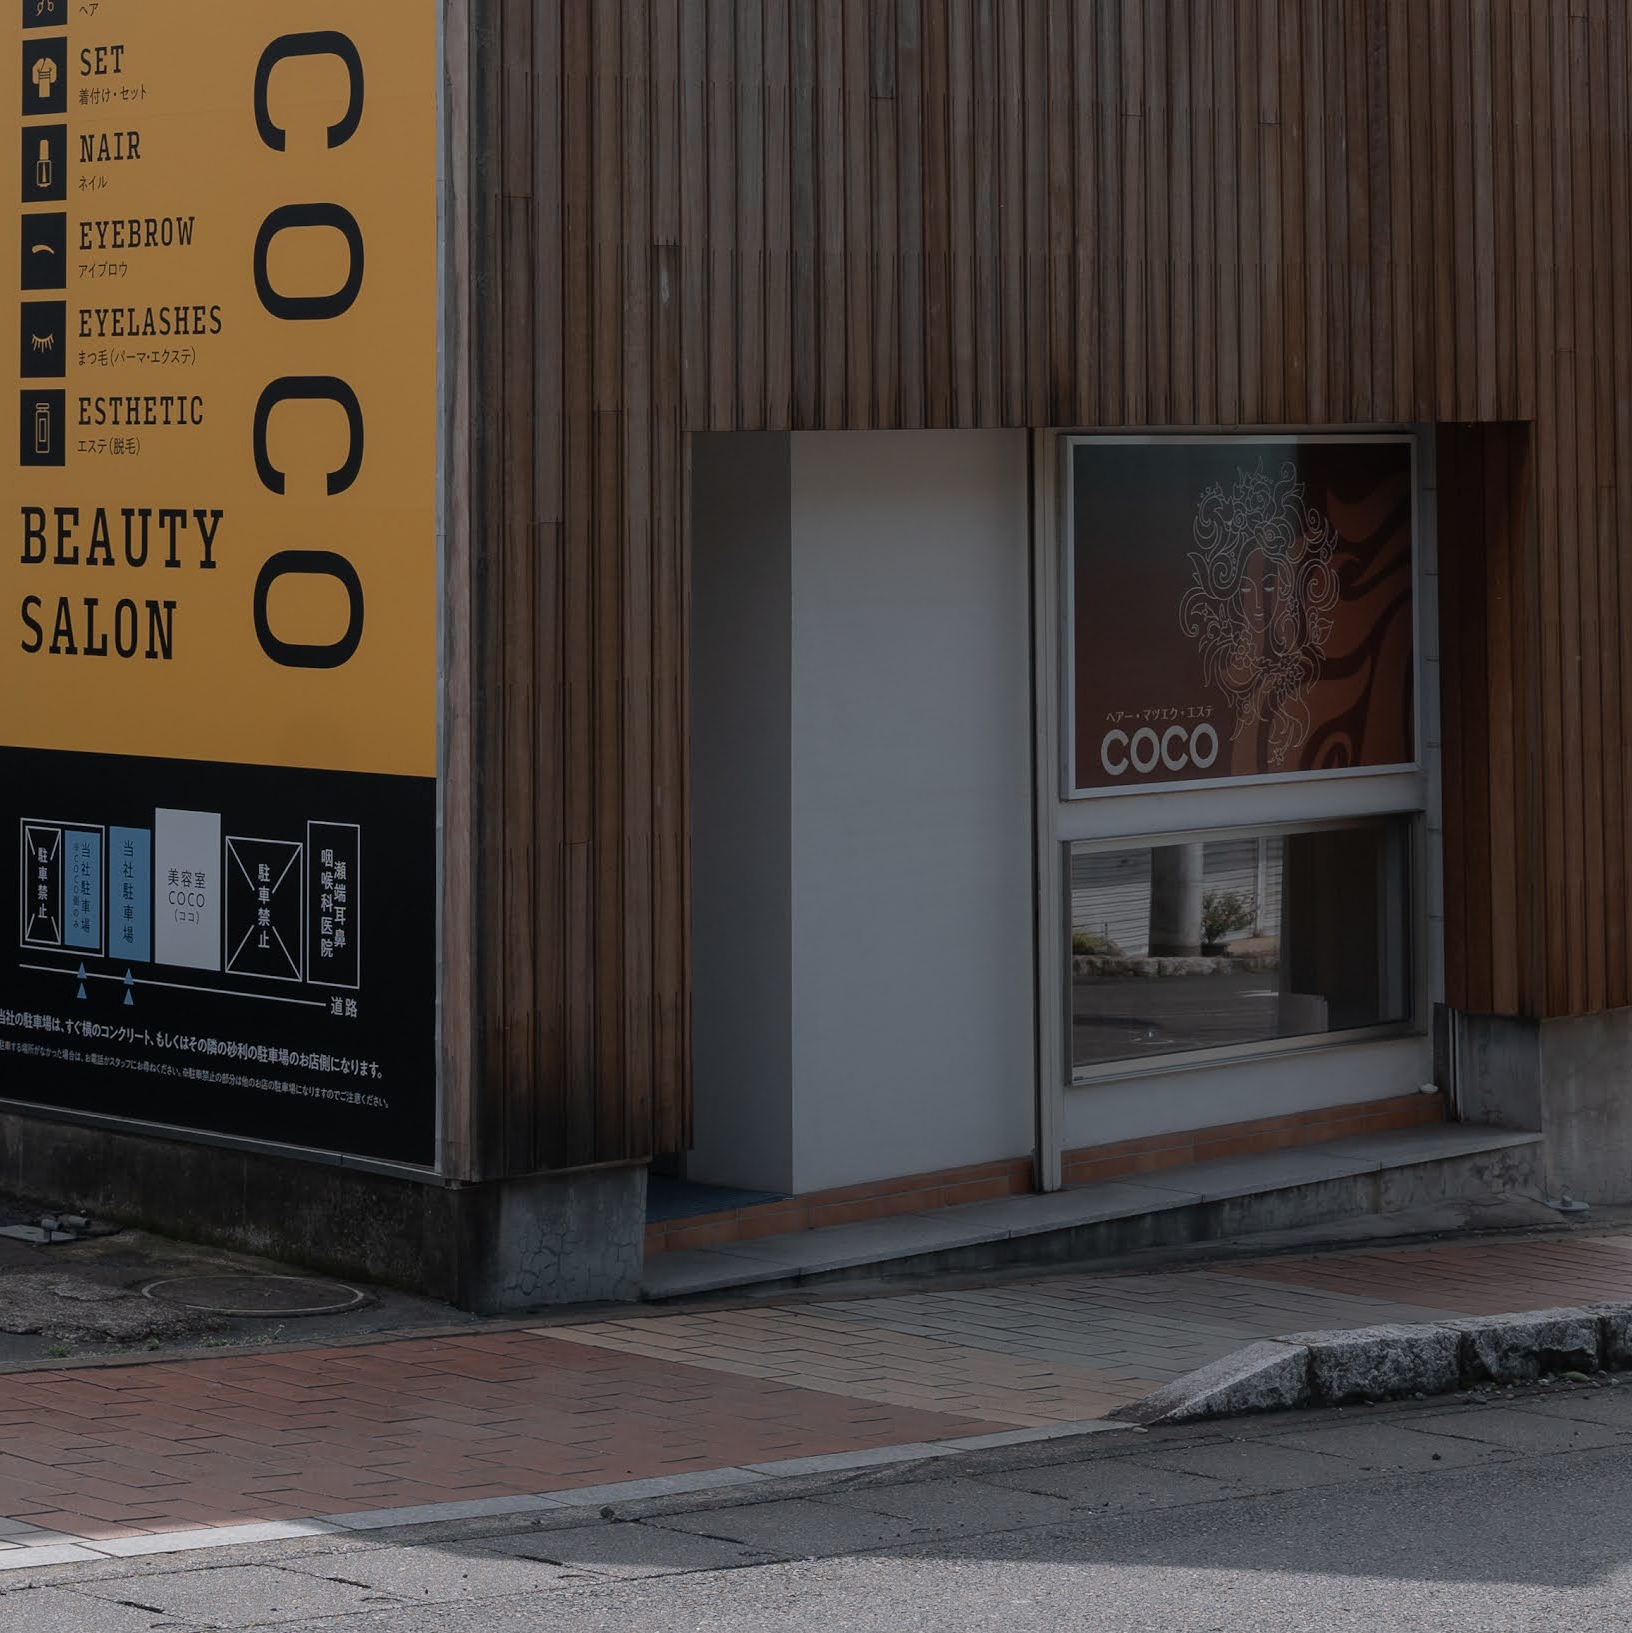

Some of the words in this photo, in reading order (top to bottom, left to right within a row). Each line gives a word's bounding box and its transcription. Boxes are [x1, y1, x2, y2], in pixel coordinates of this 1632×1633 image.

[79, 2, 99, 17] ヘア
[80, 44, 125, 77] SET
[78, 83, 148, 106] 着付け・セット
[79, 130, 141, 163] NAIR
[78, 174, 108, 192] ネイル
[79, 216, 196, 251] EYEBROW
[78, 260, 128, 279] アイブロウ
[78, 305, 223, 338] EYELASHES
[253, 29, 365, 669] COCO
[78, 395, 204, 426] ESTHETIC
[77, 437, 141, 457] エステ(脱毛)
[20, 506, 224, 569] BEAUTY
[21, 594, 177, 660] SALON
[1100, 722, 1219, 776] COCO
[37, 847, 48, 919] 駐車禁止
[123, 839, 135, 944] 当社駐車場
[168, 868, 207, 890] 美容室
[168, 890, 206, 909] COCO
[258, 863, 270, 949] 駐車禁止
[174, 908, 200, 925] (ココ)
[330, 996, 358, 1018] 道路
